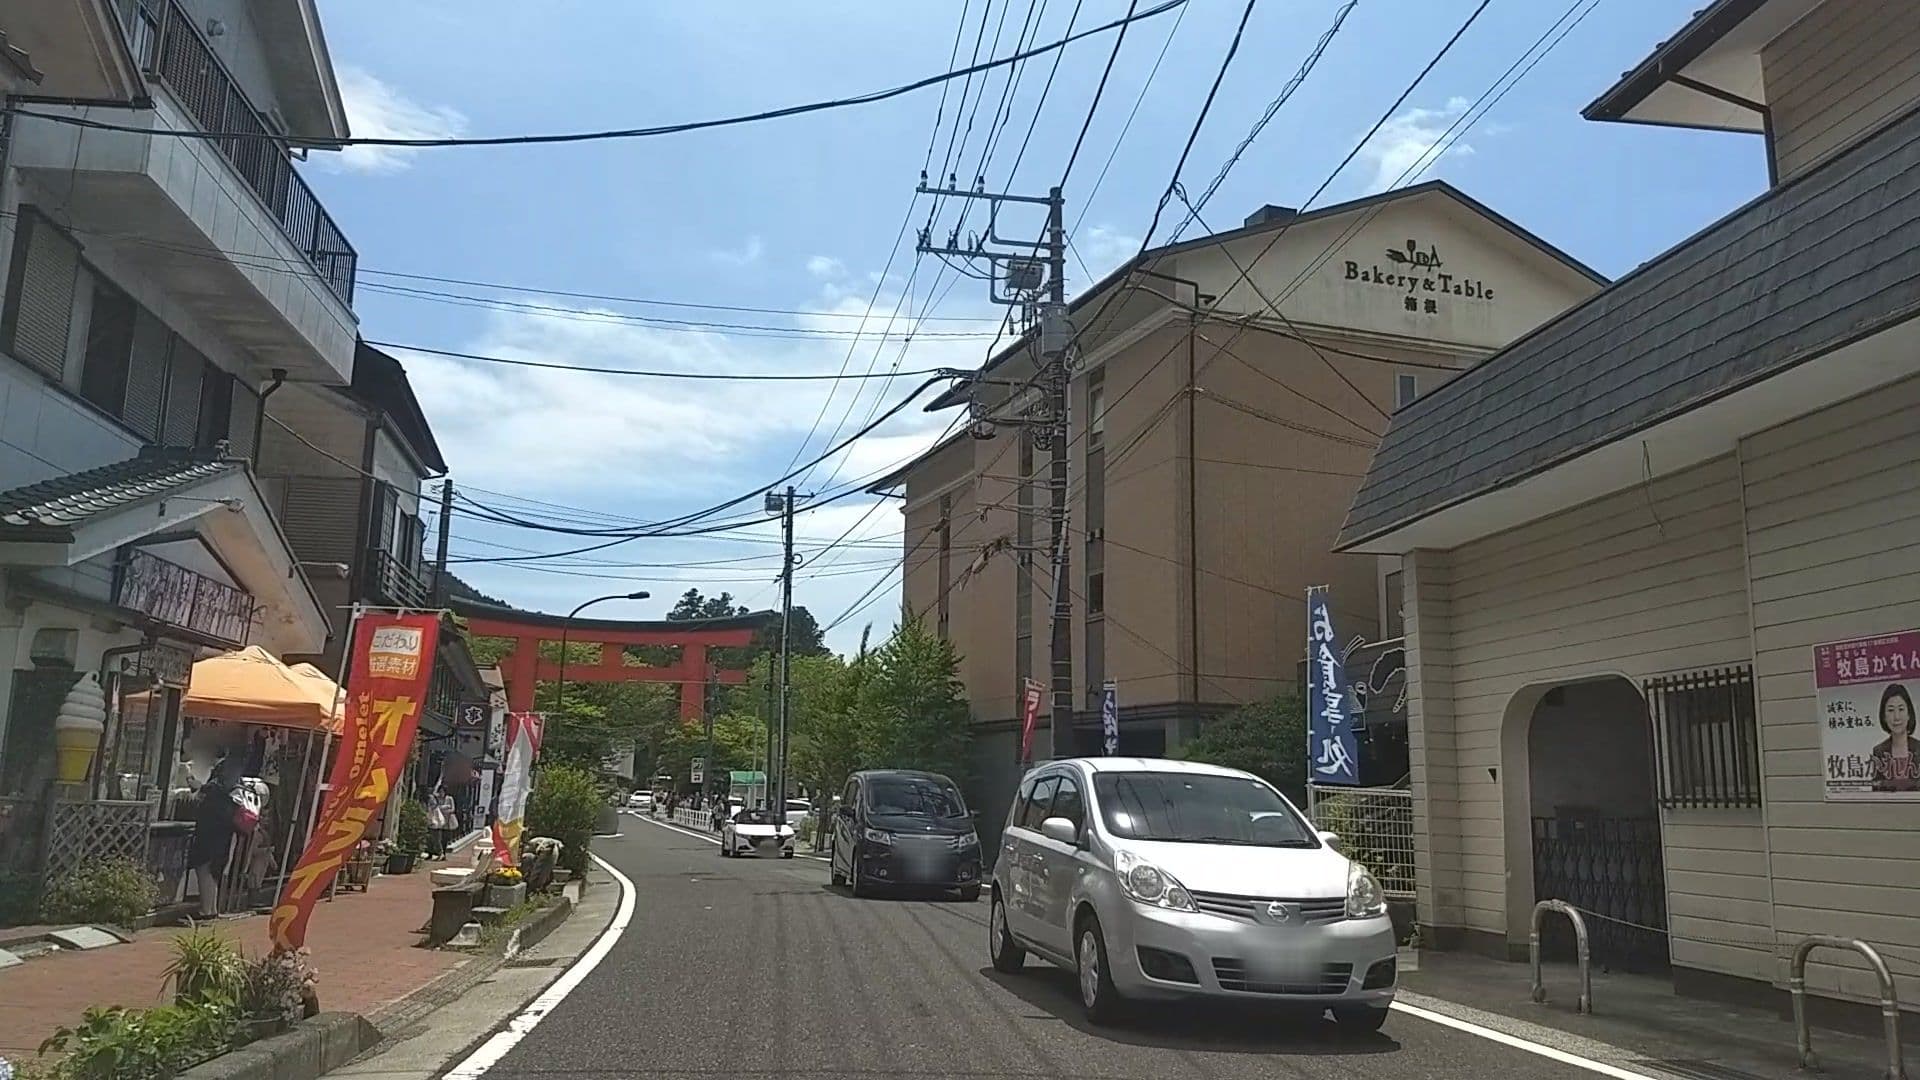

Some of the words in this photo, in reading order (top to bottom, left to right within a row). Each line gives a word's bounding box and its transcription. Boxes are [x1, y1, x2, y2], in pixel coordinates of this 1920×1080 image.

[373, 633, 419, 651] こだわり
[1836, 650, 1920, 679] 牧島かれん
[1313, 603, 1353, 777] お食事処
[350, 691, 371, 780] omelet
[1827, 752, 1920, 779] 牧島かれん
[272, 696, 417, 950] オムライス
